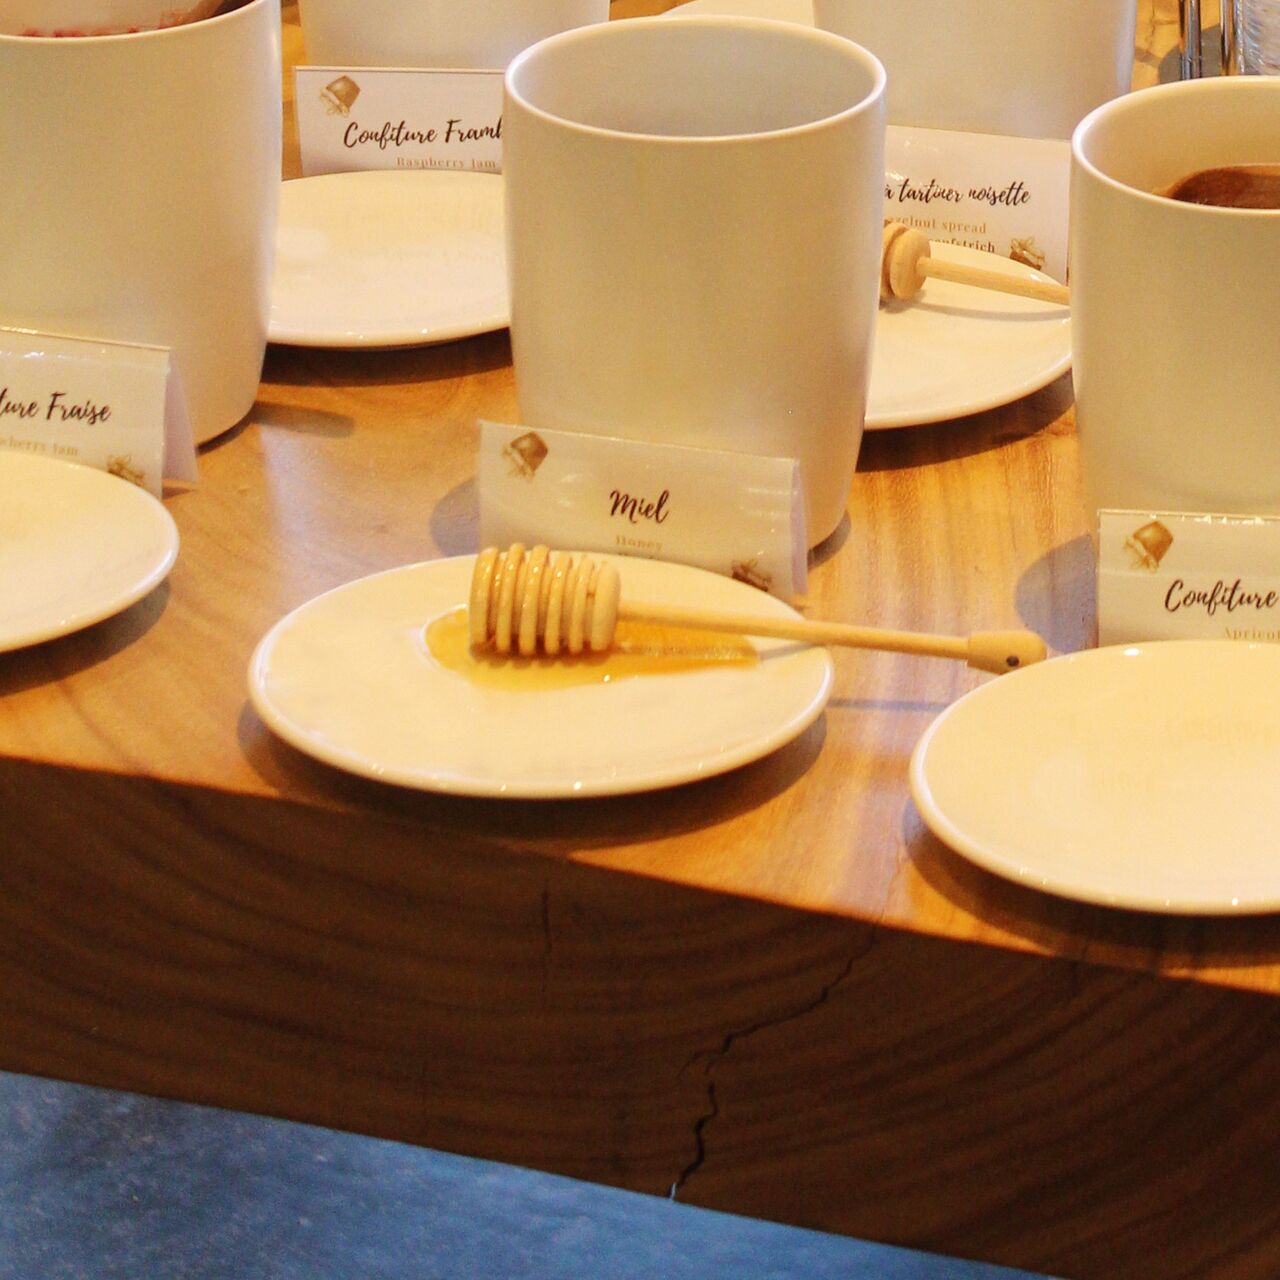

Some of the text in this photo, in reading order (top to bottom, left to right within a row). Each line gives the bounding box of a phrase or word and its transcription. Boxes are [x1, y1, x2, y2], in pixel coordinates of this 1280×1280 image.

[343, 120, 438, 150] Confiture
[397, 157, 464, 169] Raspberry
[898, 178, 962, 203] tartiner
[968, 181, 1031, 206] noisette
[942, 222, 987, 234] spread
[46, 391, 112, 425] Fraise
[609, 489, 670, 524] Miel
[1164, 579, 1280, 616] Confiture
